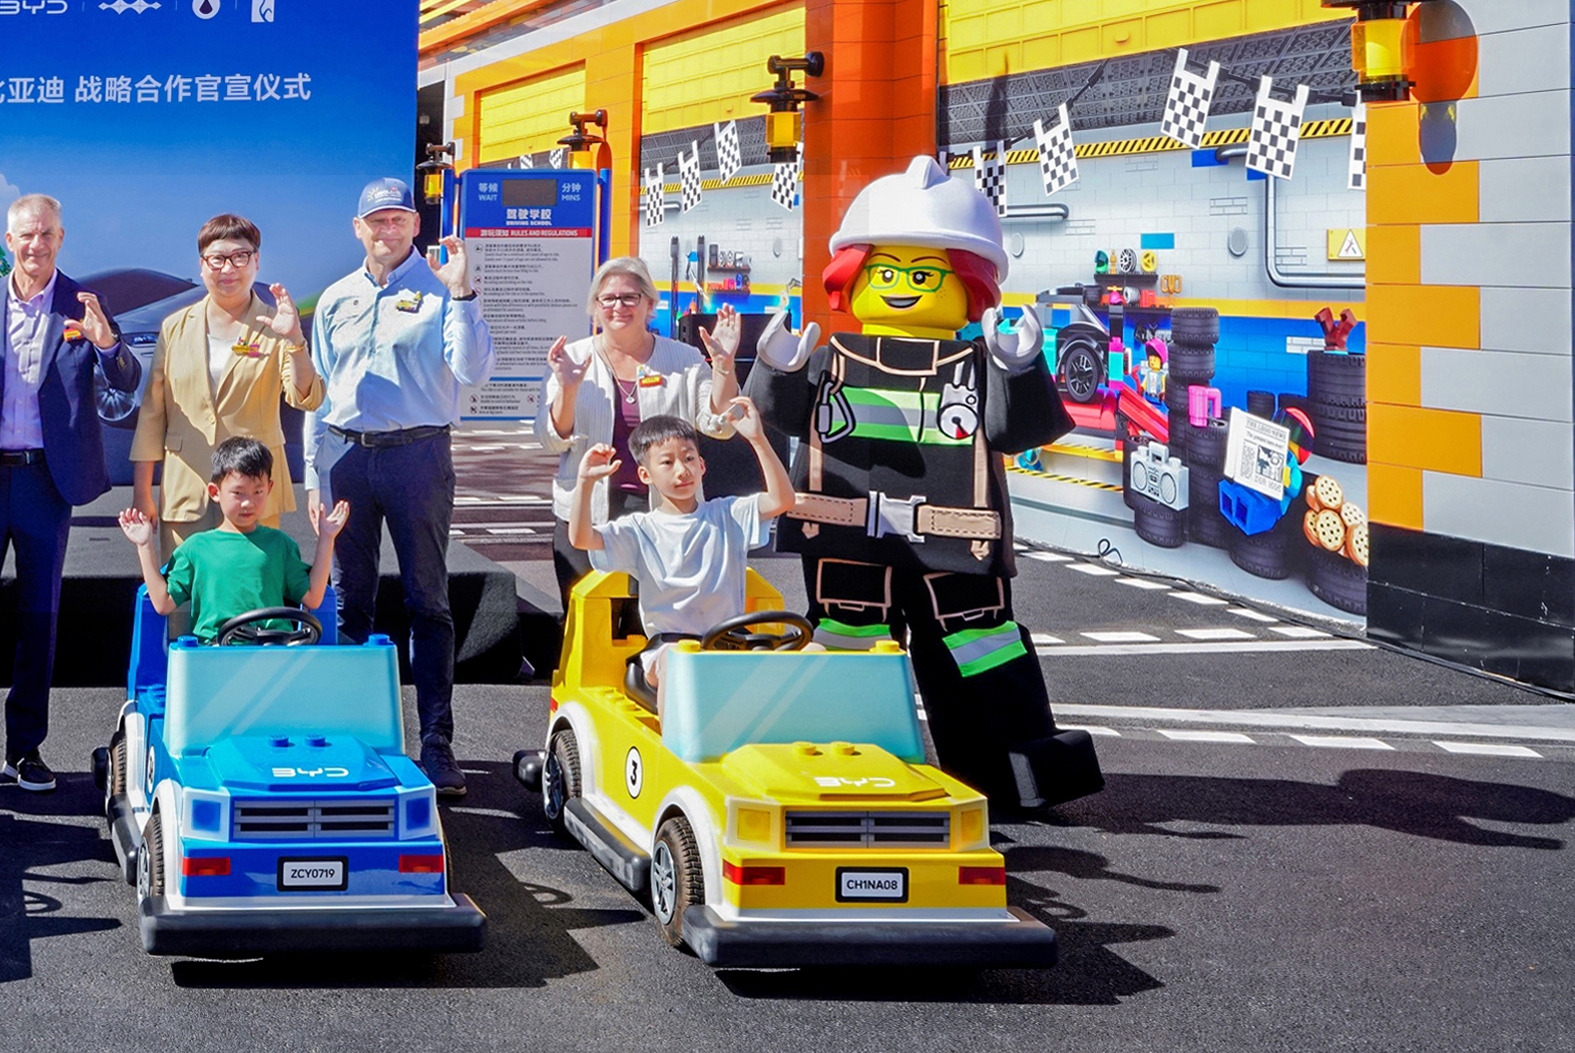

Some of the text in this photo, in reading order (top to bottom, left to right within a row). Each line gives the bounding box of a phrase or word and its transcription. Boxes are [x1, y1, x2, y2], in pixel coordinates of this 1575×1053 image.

[0, 0, 69, 15] BYD
[74, 72, 312, 103] 战略合作官宣仪式
[561, 194, 581, 202] MINS
[510, 229, 528, 237] RULES
[528, 229, 540, 237] AND
[541, 229, 578, 237] REGULATIONS
[272, 767, 349, 778] BYD
[629, 760, 639, 785] 3
[813, 776, 896, 788] BYD
[290, 867, 335, 879] ZCY0719
